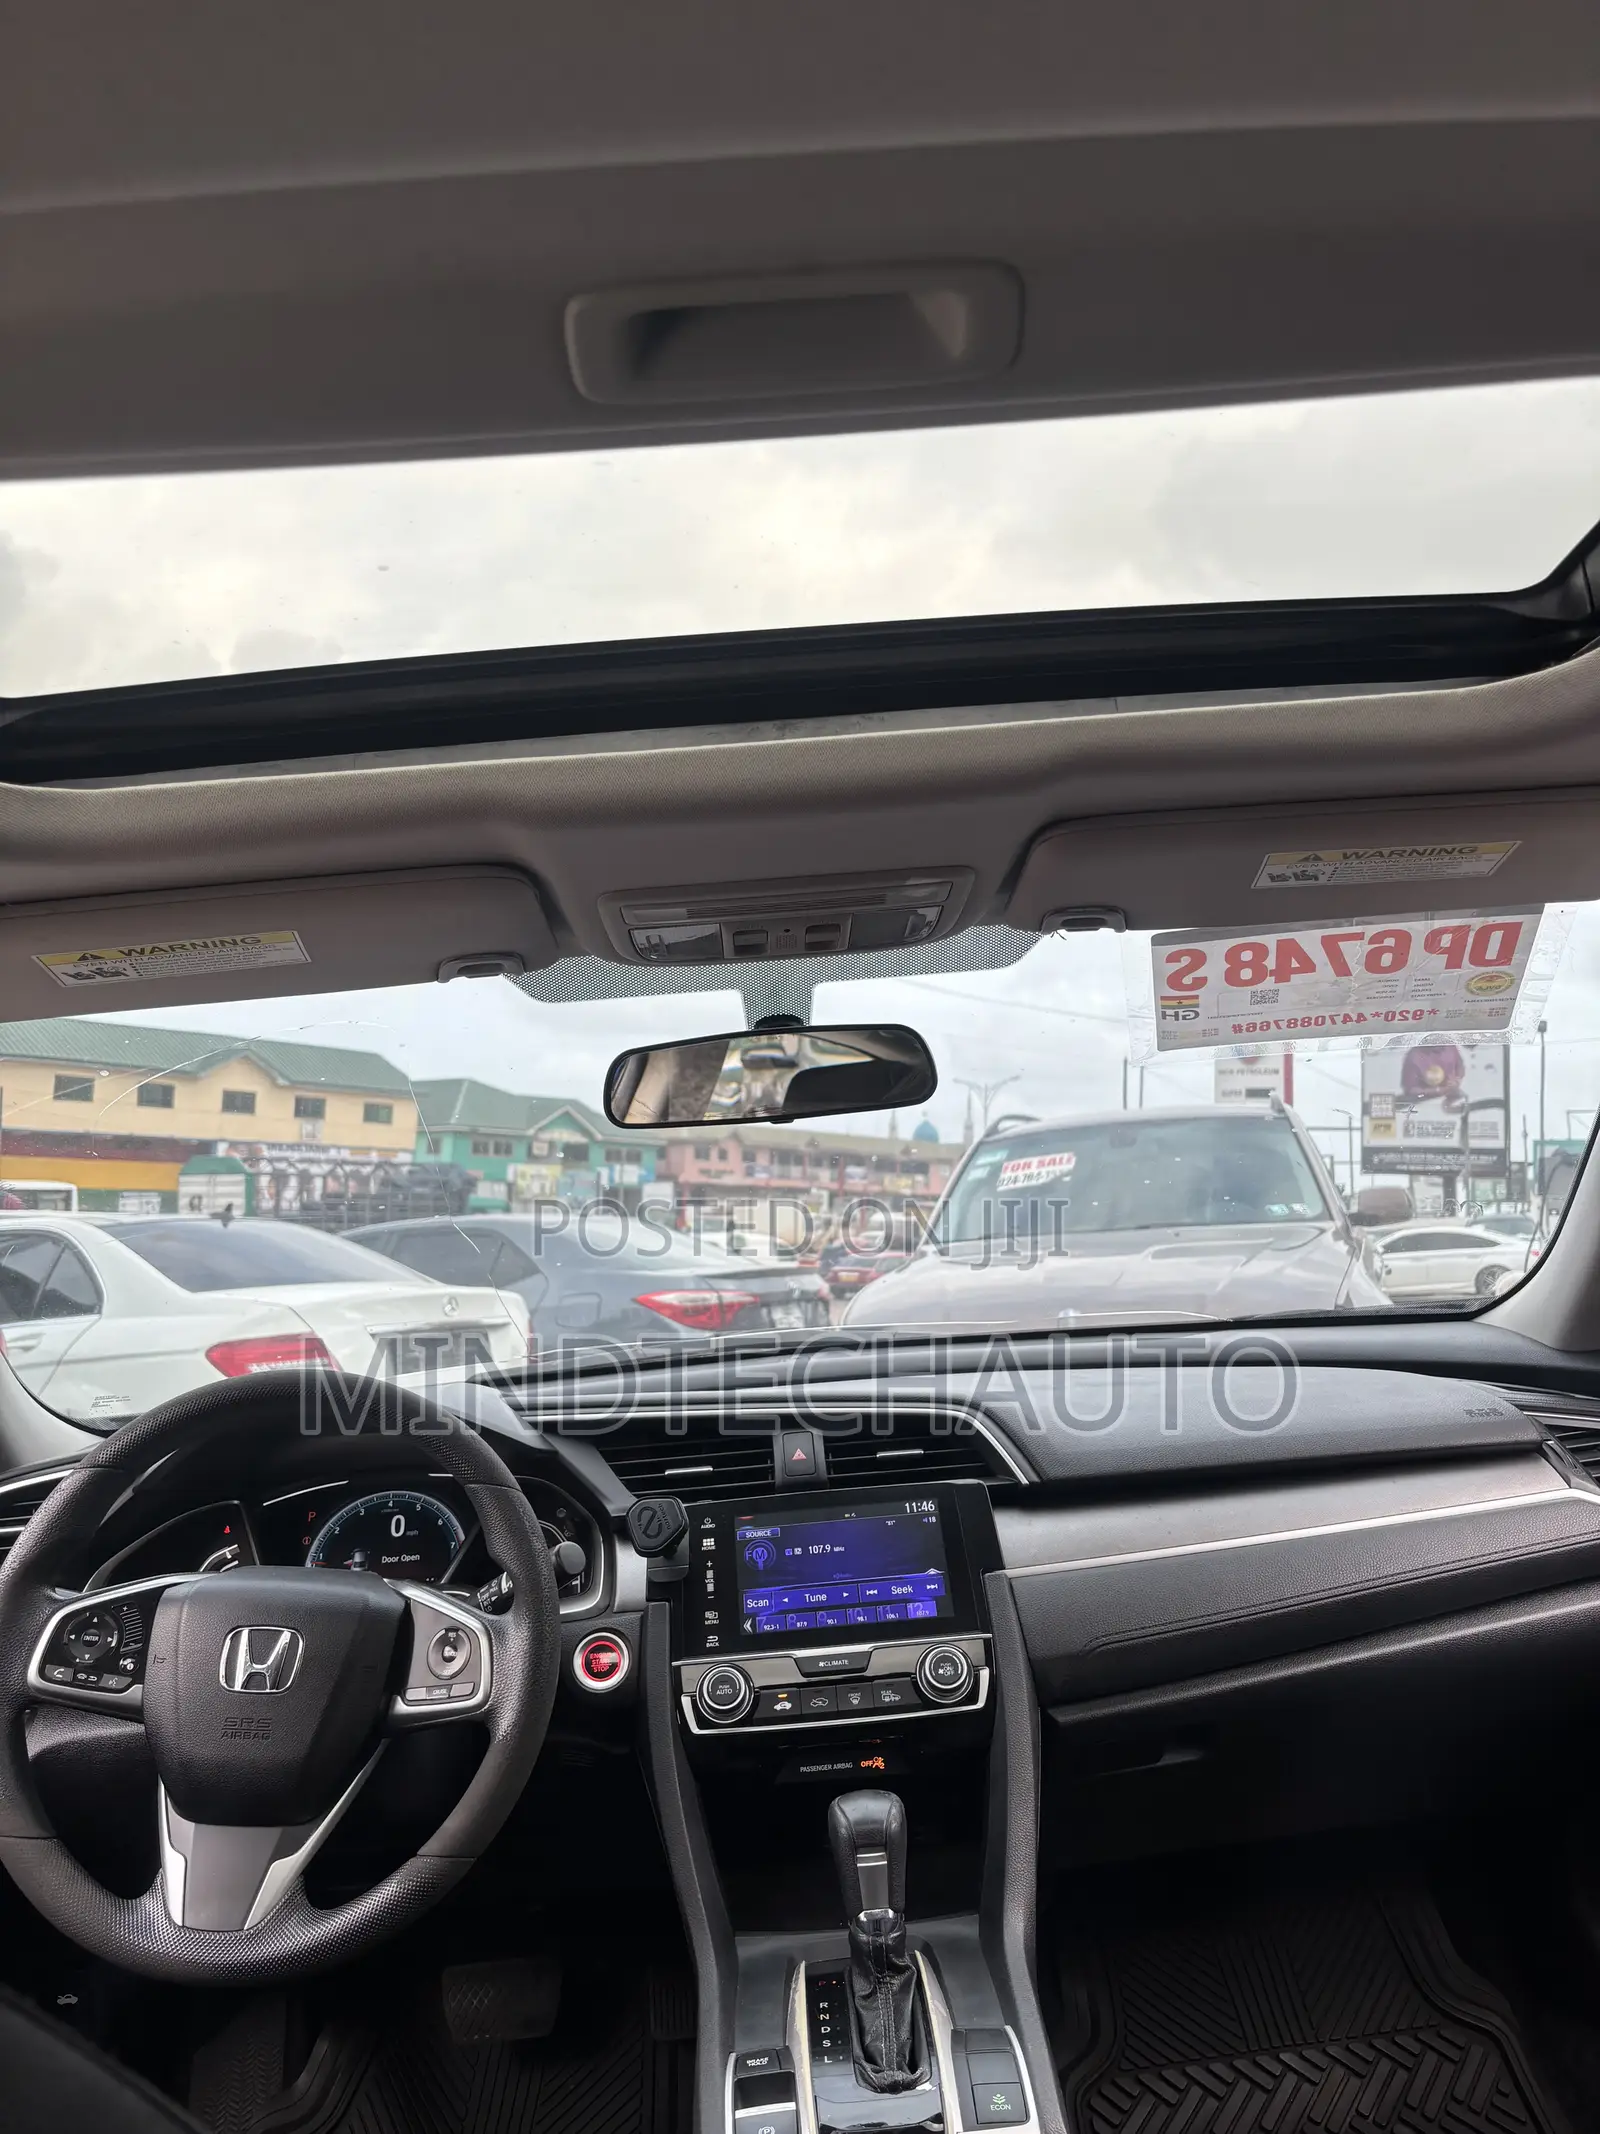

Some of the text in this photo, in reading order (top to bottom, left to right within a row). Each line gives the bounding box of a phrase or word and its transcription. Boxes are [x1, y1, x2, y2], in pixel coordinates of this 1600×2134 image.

[1341, 846, 1479, 860] WARNING
[1286, 862, 1320, 870] EVEN
[1358, 858, 1419, 866] ADVANCED
[118, 936, 262, 958] WARNING
[73, 943, 276, 968] EVEN WITH ADVANCED AIR BAGS
[1003, 1153, 1074, 1174] FOR SALE
[905, 1500, 935, 1513] 11:46
[308, 1512, 316, 1522] P
[390, 1515, 406, 1537] 0
[746, 1530, 772, 1538] SOURCE
[808, 1545, 831, 1554] 107.9
[382, 1554, 420, 1564] Door Open
[891, 1585, 913, 1595] Seek
[747, 1598, 769, 1608] Scan
[805, 1593, 827, 1602] Tune
[223, 1717, 272, 1728] SRS
[221, 1730, 272, 1740] AIRBAG
[800, 1760, 873, 1773] PASSENGER AIRBAG OFF
